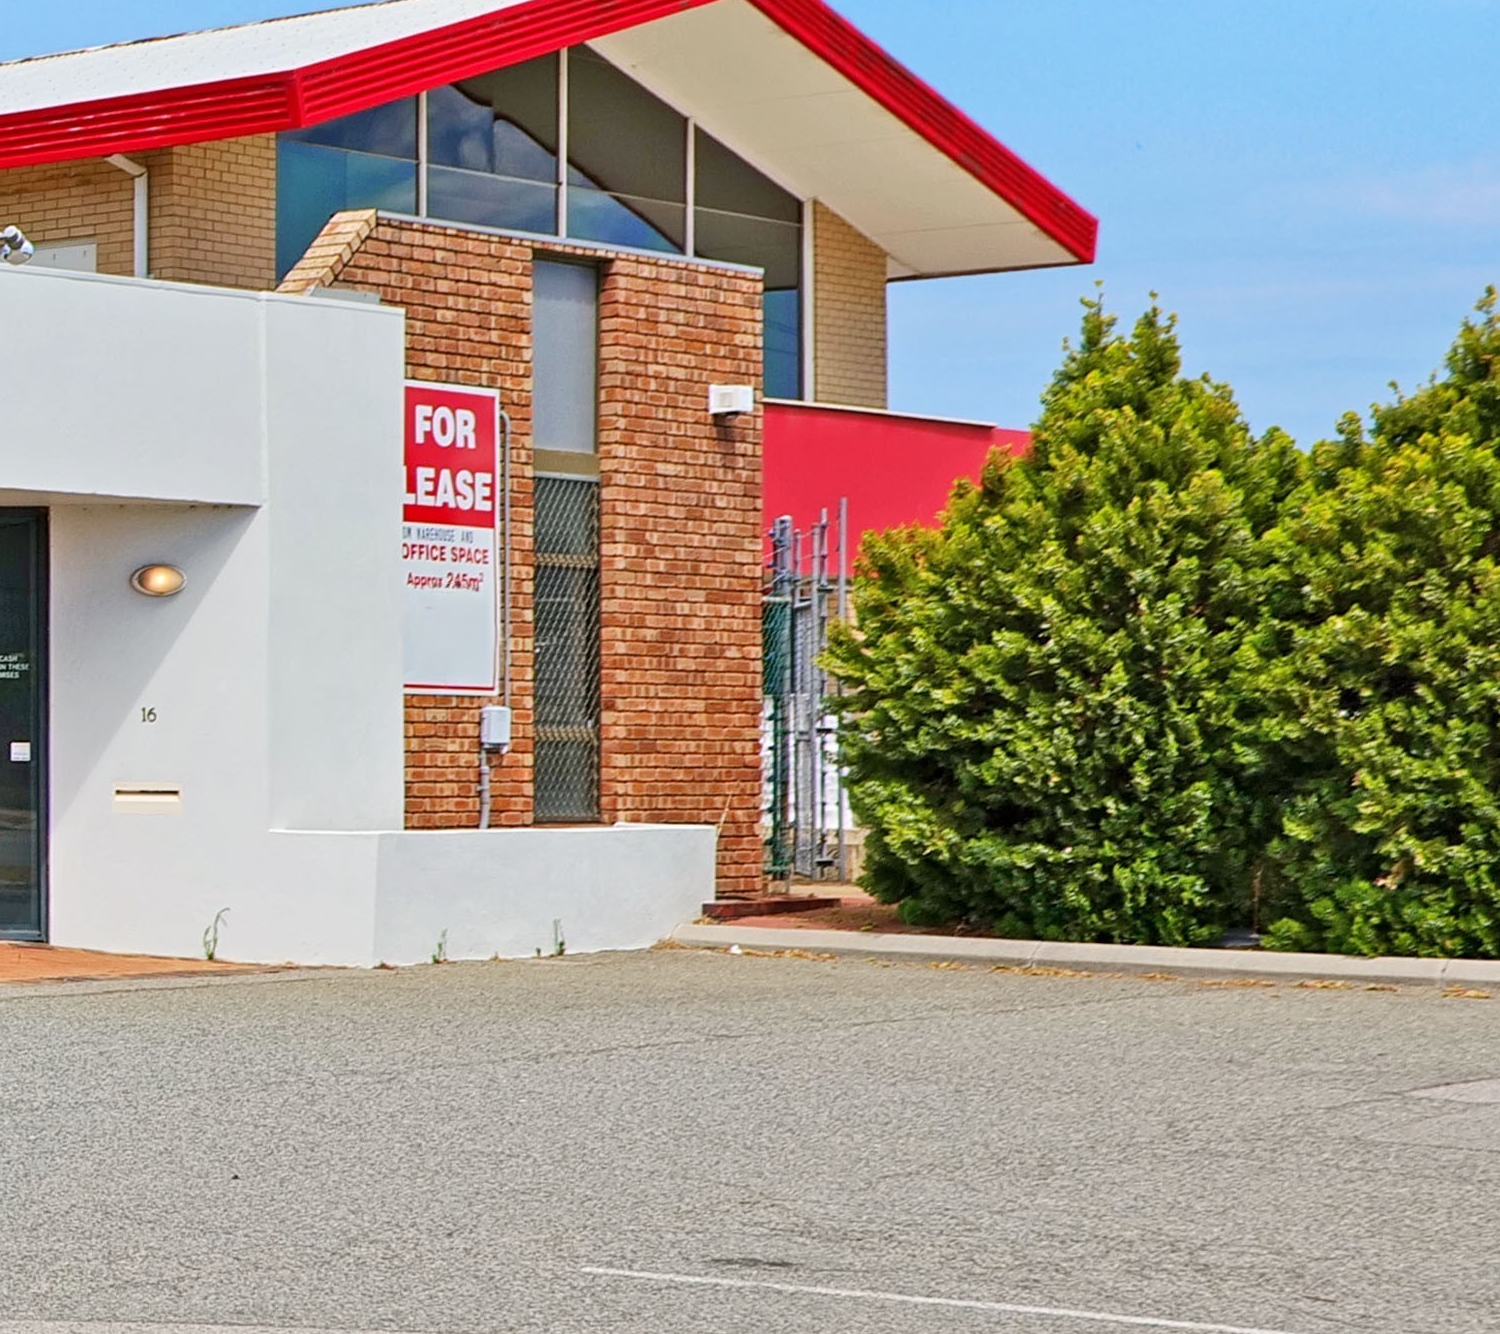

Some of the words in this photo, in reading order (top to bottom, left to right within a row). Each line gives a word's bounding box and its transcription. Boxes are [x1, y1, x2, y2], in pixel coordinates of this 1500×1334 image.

[415, 404, 476, 449] FOR
[403, 465, 492, 512] LEASE
[402, 542, 447, 562] OFFICE
[451, 546, 489, 565] SPACE
[407, 571, 442, 589] Approx
[0, 654, 18, 662] CASH
[8, 663, 29, 671] THESE
[141, 707, 157, 723] 16
